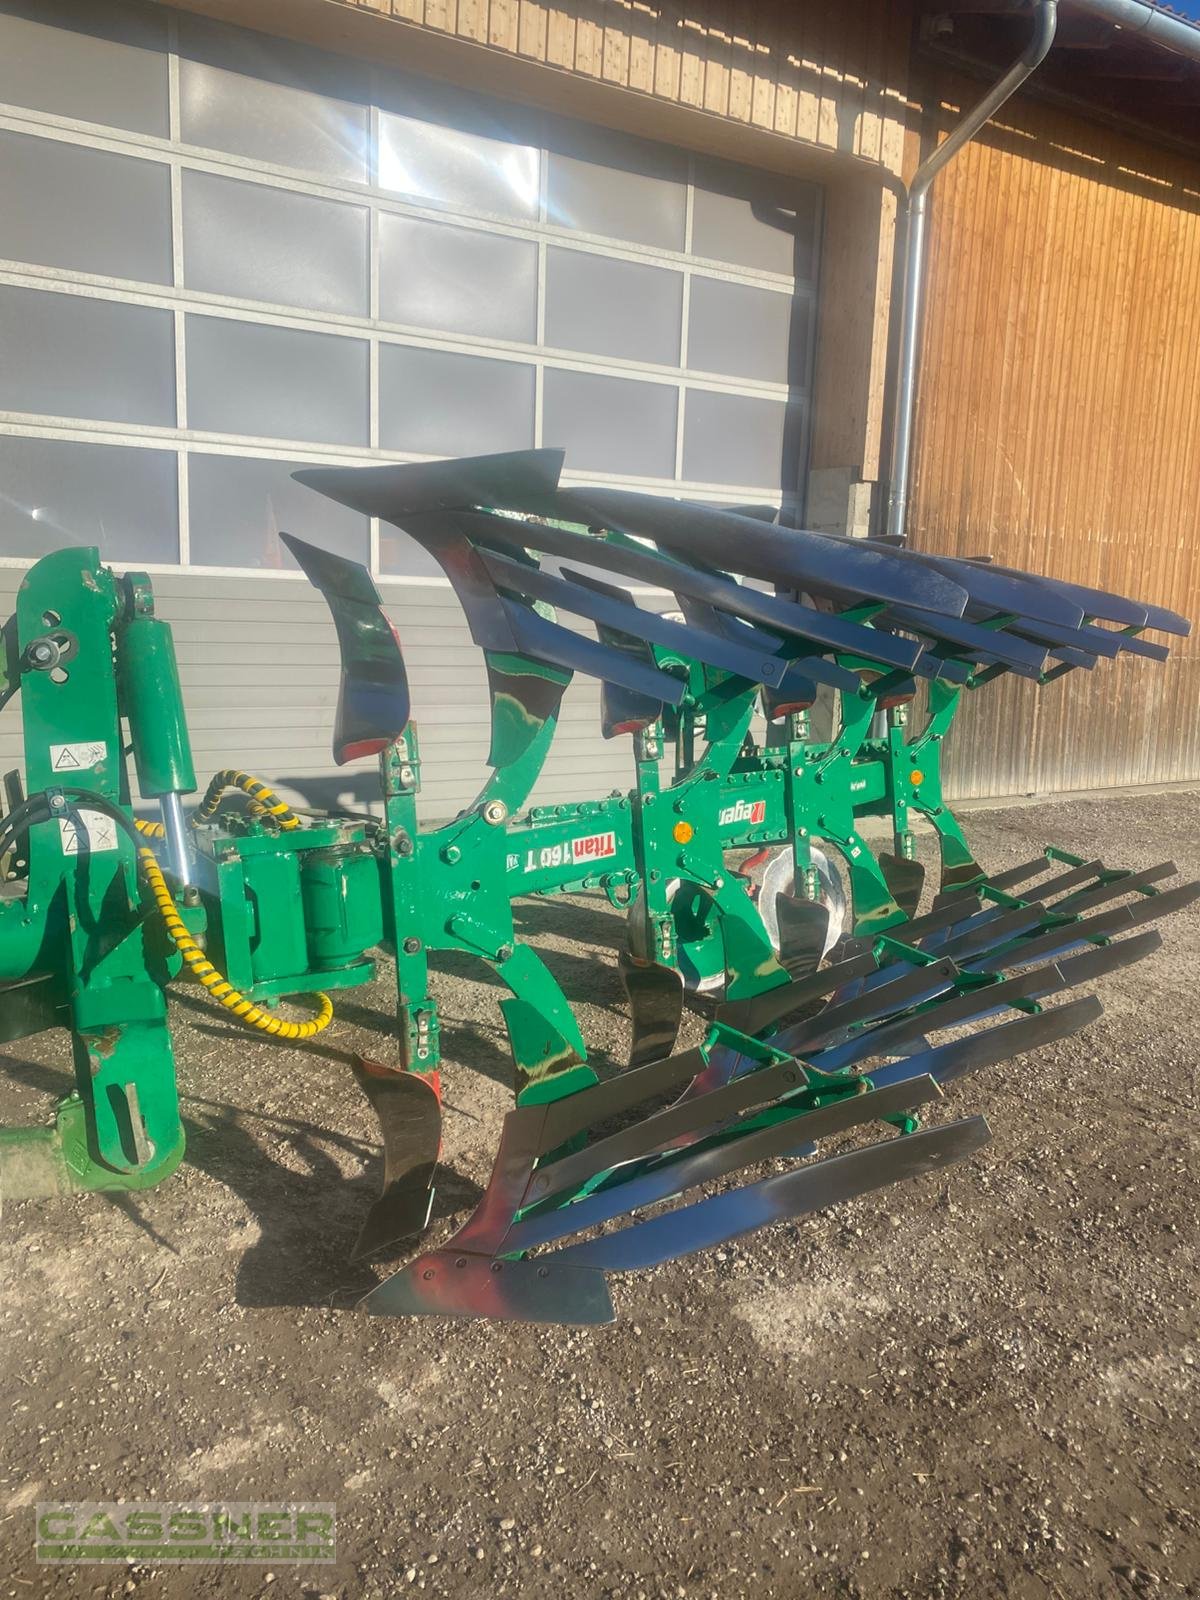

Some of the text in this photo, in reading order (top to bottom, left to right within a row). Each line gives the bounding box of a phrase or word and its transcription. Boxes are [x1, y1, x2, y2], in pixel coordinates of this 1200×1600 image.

[542, 842, 571, 867] 160
[574, 835, 614, 857] Titan
[524, 850, 537, 872] T
